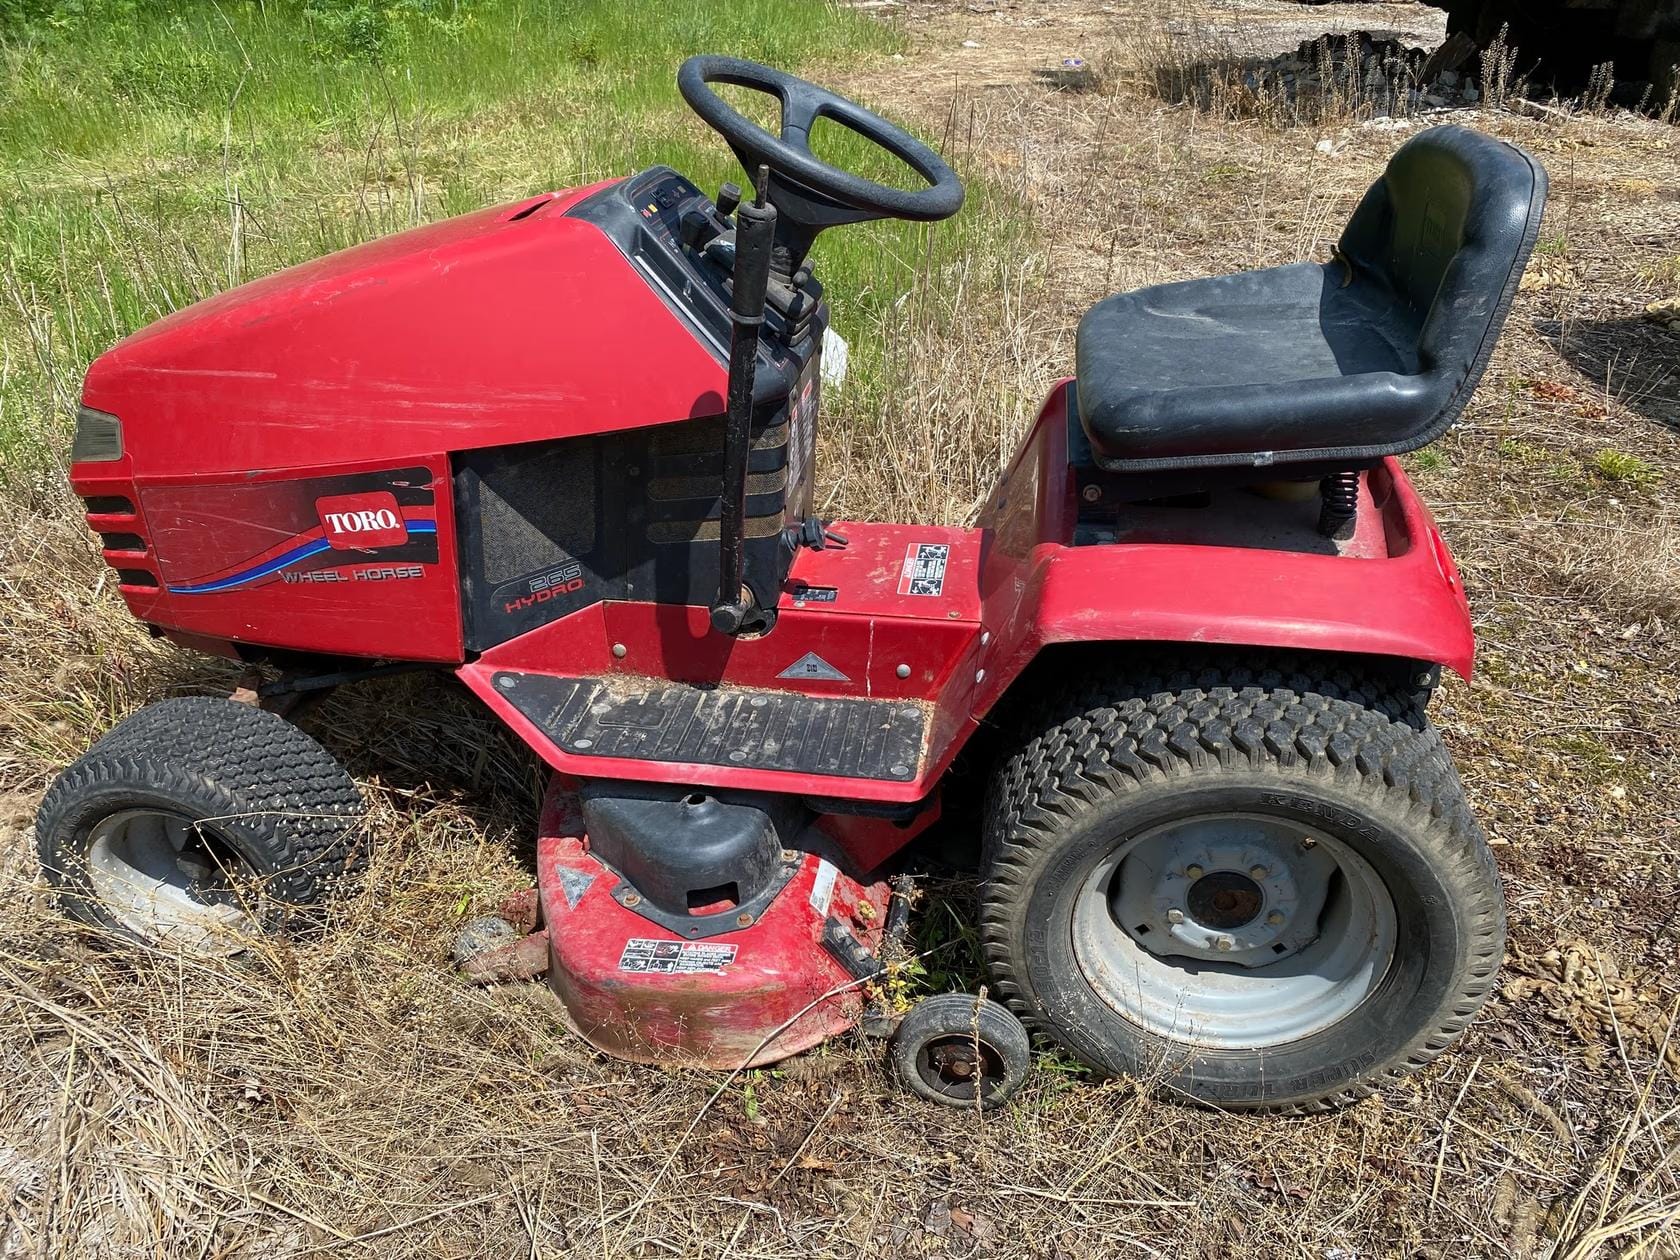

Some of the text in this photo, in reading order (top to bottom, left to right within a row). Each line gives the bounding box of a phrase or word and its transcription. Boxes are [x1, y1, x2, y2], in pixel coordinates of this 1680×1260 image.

[281, 565, 425, 584] WHEEL HORSE
[528, 565, 583, 594] 265
[505, 579, 584, 613] HYDRO
[1260, 791, 1383, 844] KENDA
